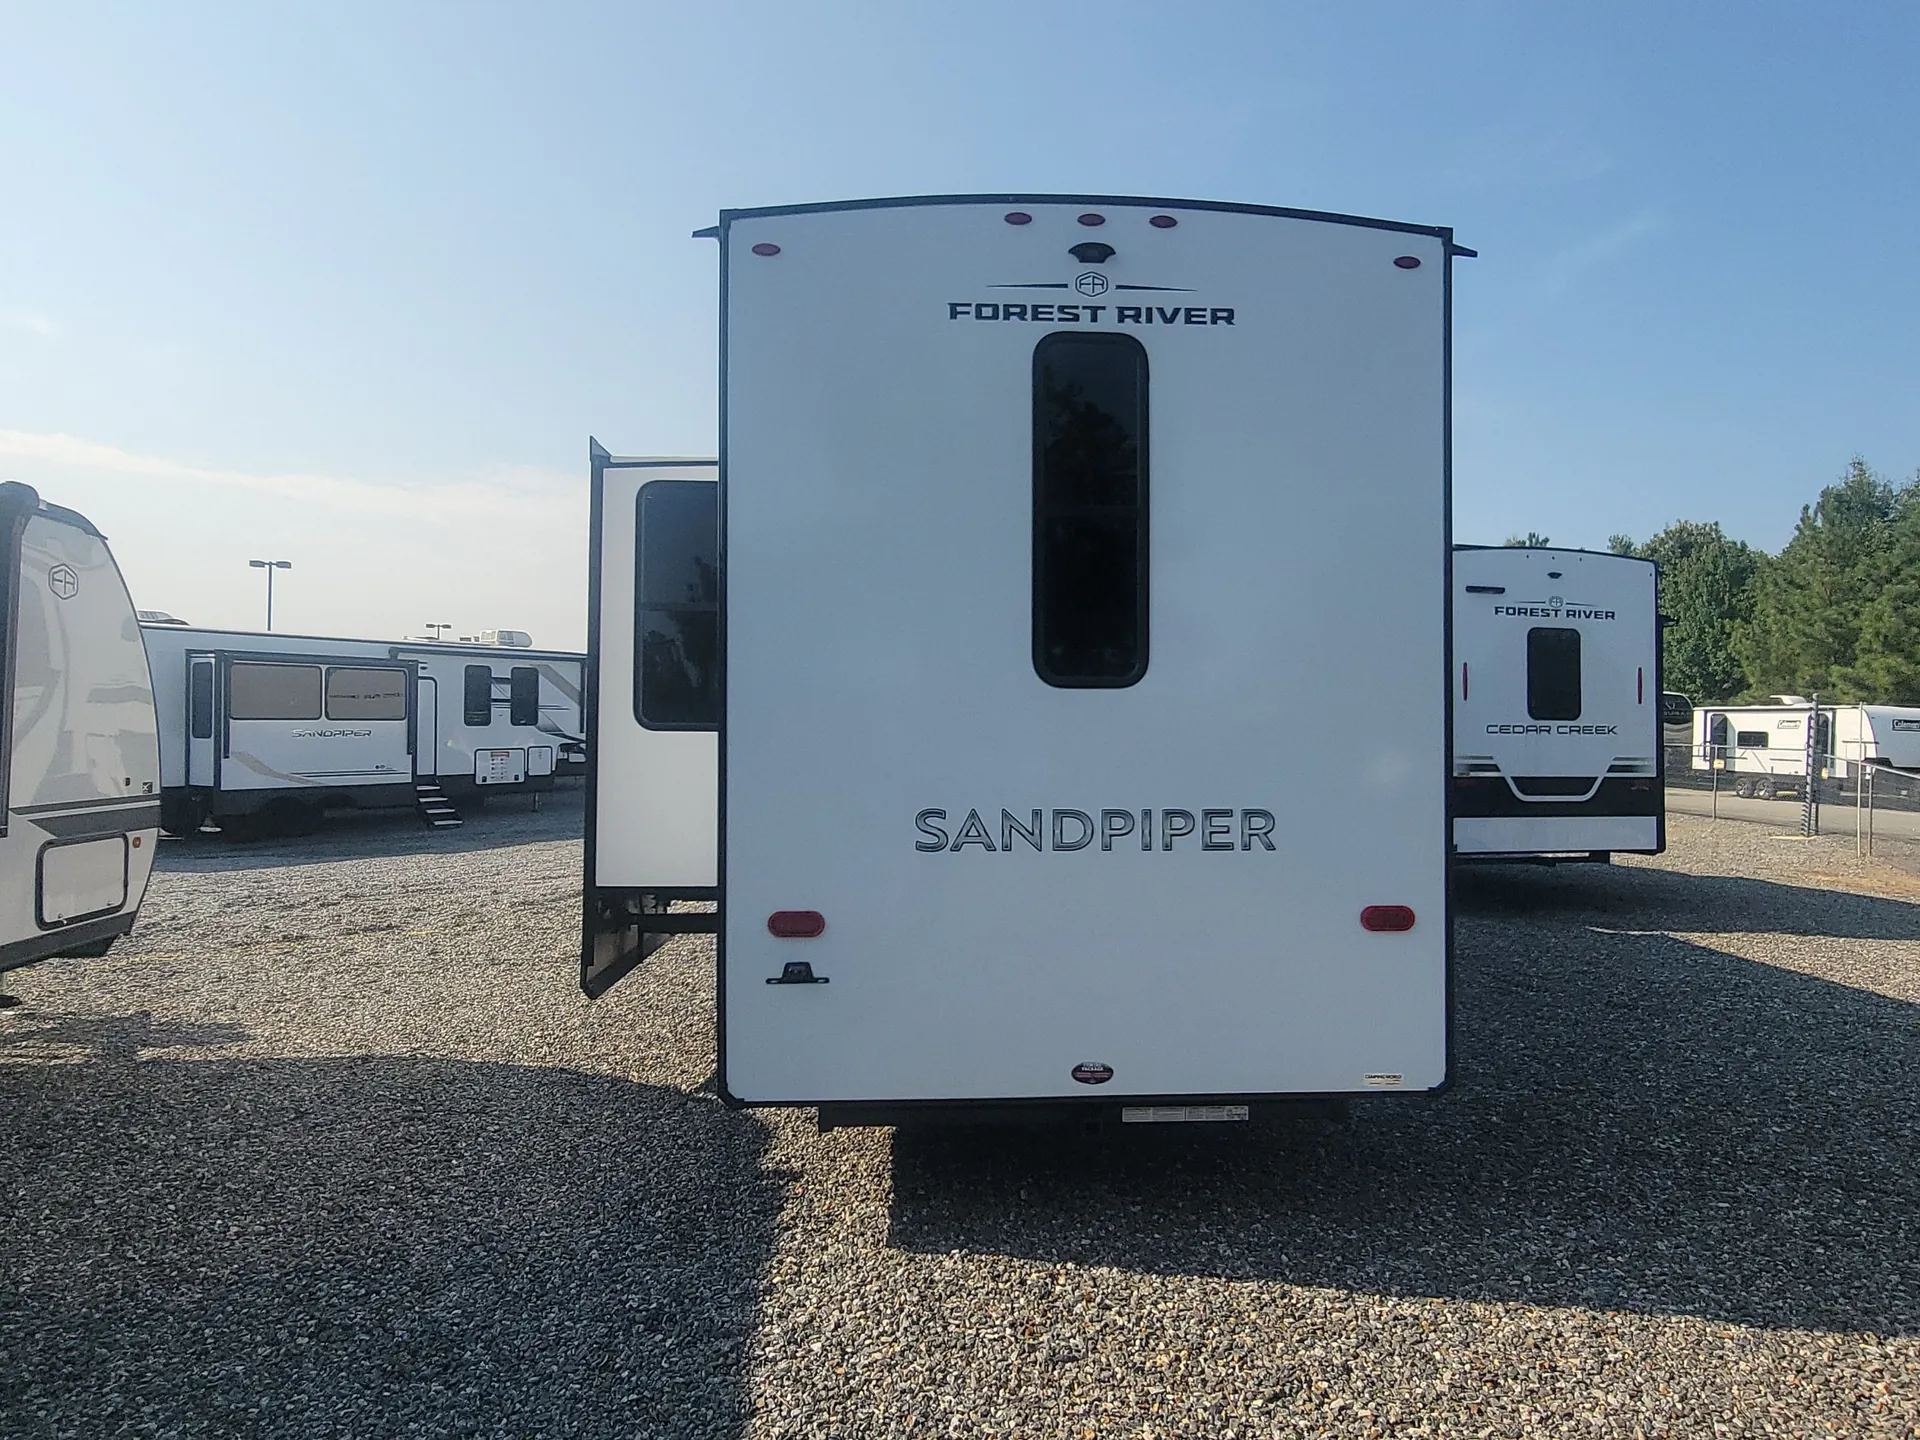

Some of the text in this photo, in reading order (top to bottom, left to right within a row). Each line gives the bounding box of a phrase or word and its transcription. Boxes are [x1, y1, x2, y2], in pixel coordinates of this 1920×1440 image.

[948, 302, 1236, 326] FOREST RIVER
[1494, 606, 1616, 620] FOREST RIVER
[292, 729, 372, 738] SANDPIPER
[1486, 724, 1618, 735] CEDAR CREEK
[915, 808, 1276, 852] SANDPIPER
